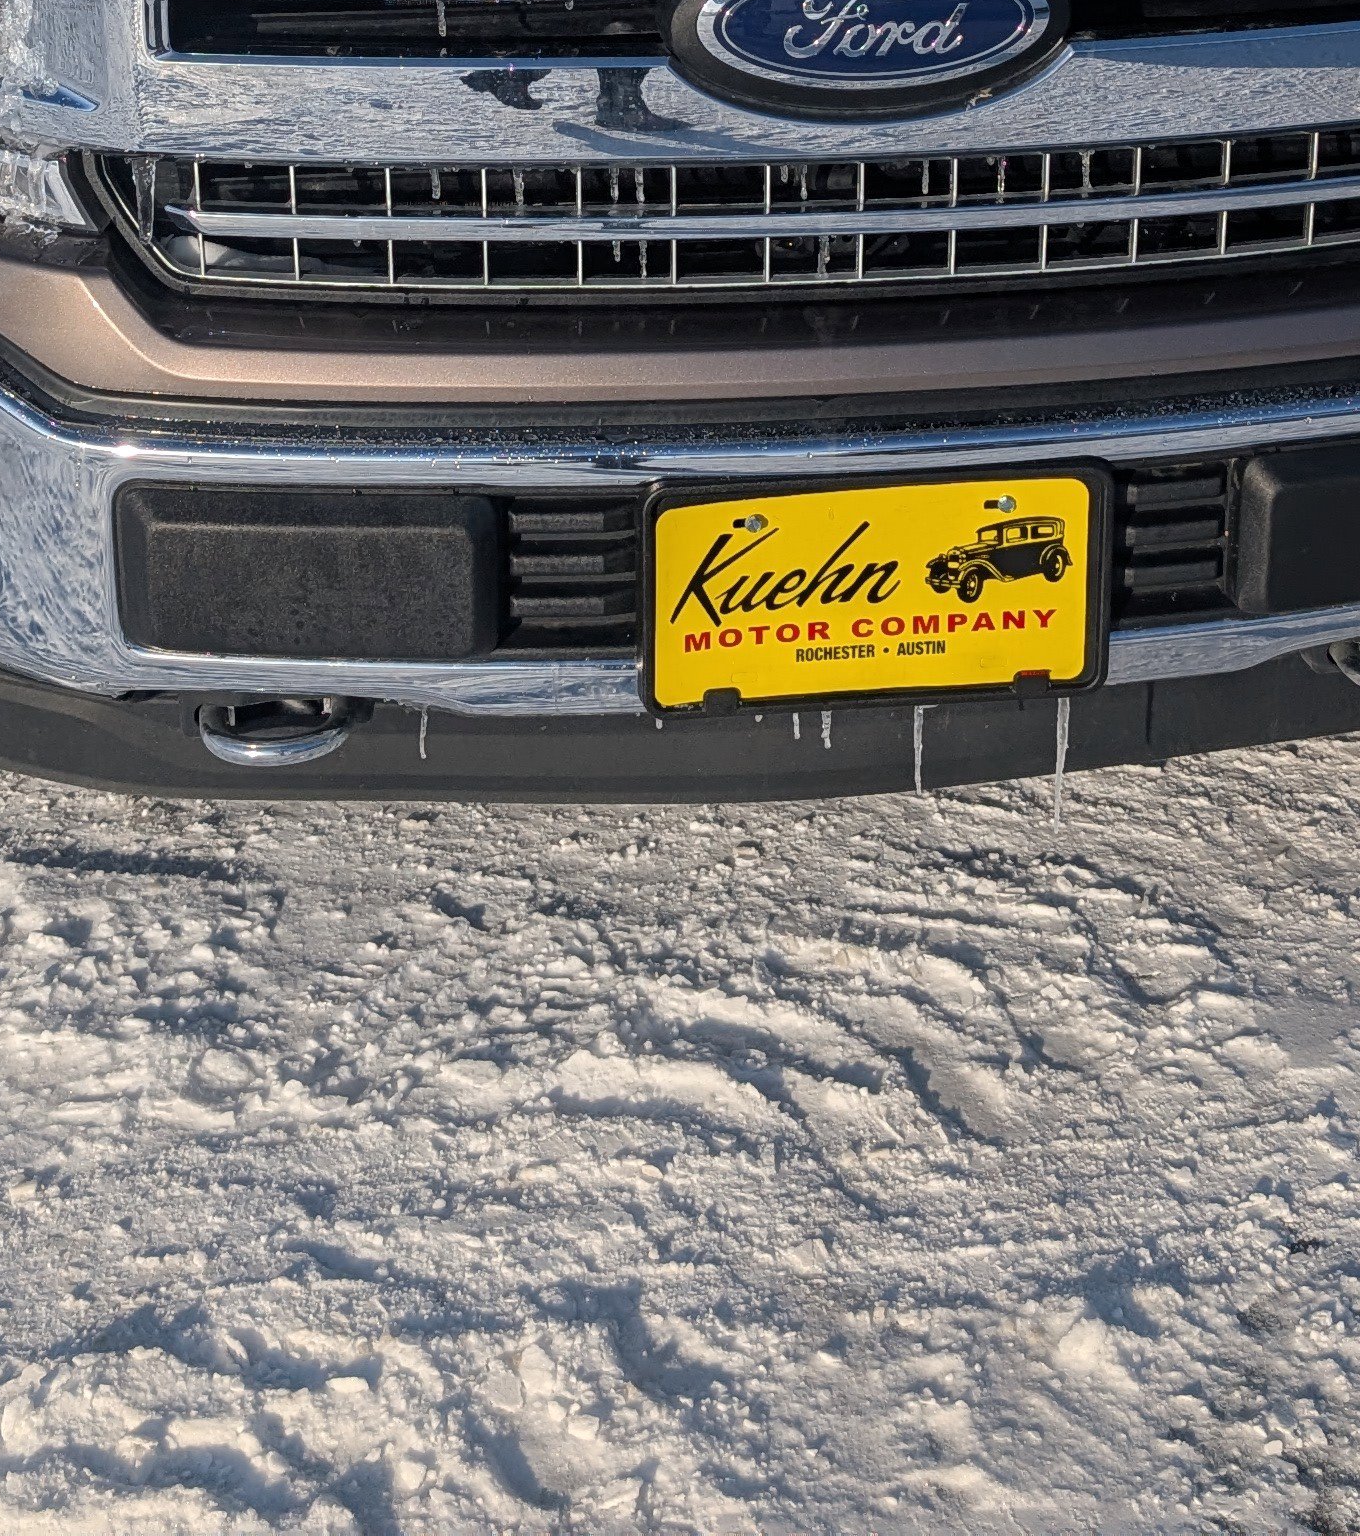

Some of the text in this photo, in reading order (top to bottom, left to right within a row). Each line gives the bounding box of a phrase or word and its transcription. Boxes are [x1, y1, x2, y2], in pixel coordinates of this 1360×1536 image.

[669, 520, 901, 627] Kuehn
[683, 608, 1058, 653] MOTOR COMPANY
[795, 640, 947, 663] ROCHESTER AUSTIN
